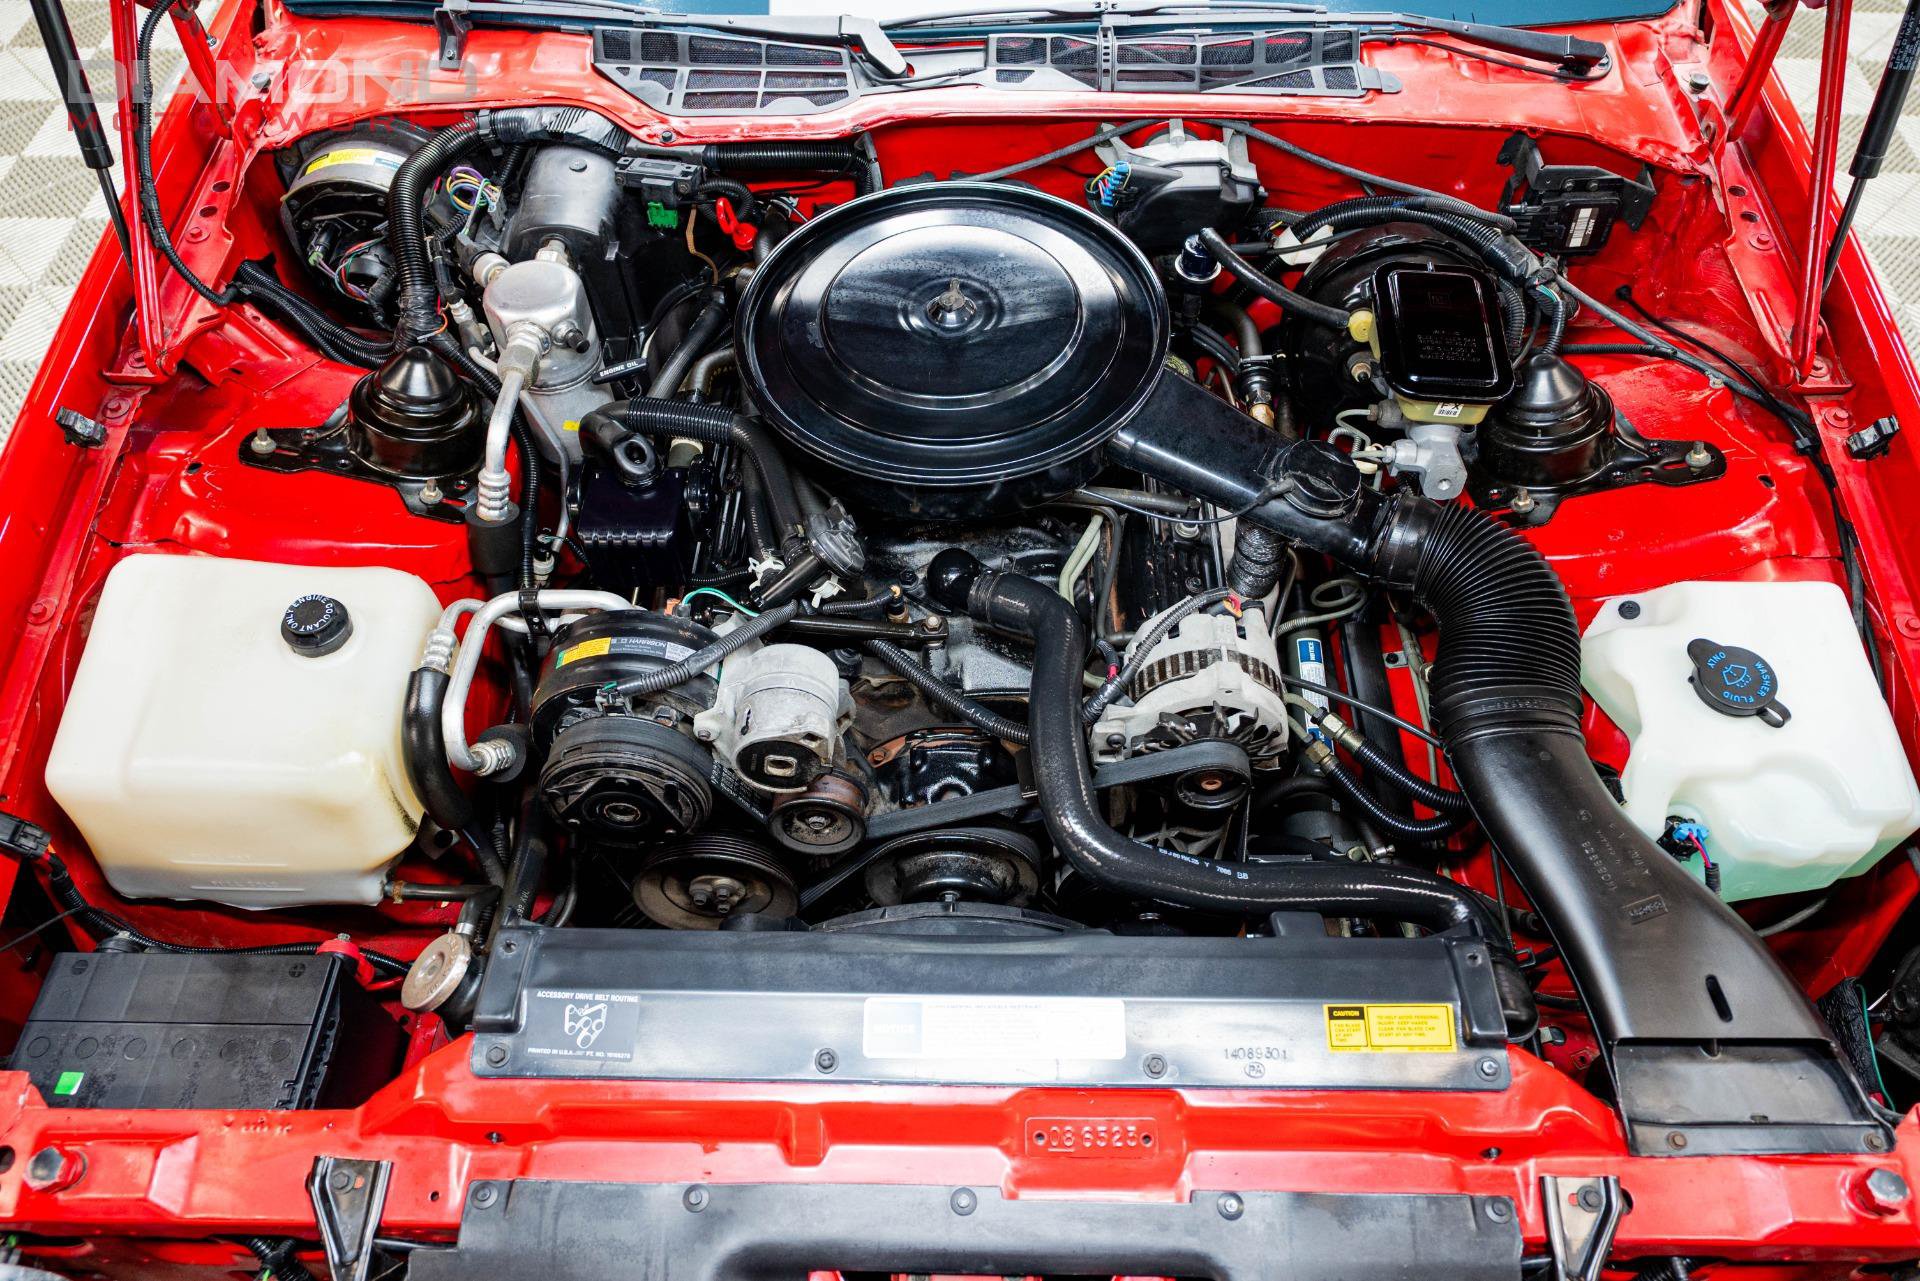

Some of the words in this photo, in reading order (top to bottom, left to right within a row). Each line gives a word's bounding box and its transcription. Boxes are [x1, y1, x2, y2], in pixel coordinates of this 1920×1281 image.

[599, 364, 625, 377] ENGINE
[626, 360, 639, 368] OIL
[292, 594, 327, 608] ENGINE
[285, 609, 299, 629] ONLY
[299, 603, 334, 632] COOLANT
[1706, 651, 1727, 669] ONLY
[1755, 661, 1771, 697] WASHER
[1722, 691, 1755, 703] FLUID
[537, 990, 575, 1000] ACCESSORY
[574, 992, 594, 1001] DRIVE
[594, 994, 610, 1002] BELT
[610, 995, 640, 1003] ROUTING
[1332, 1010, 1360, 1018] CAUTION
